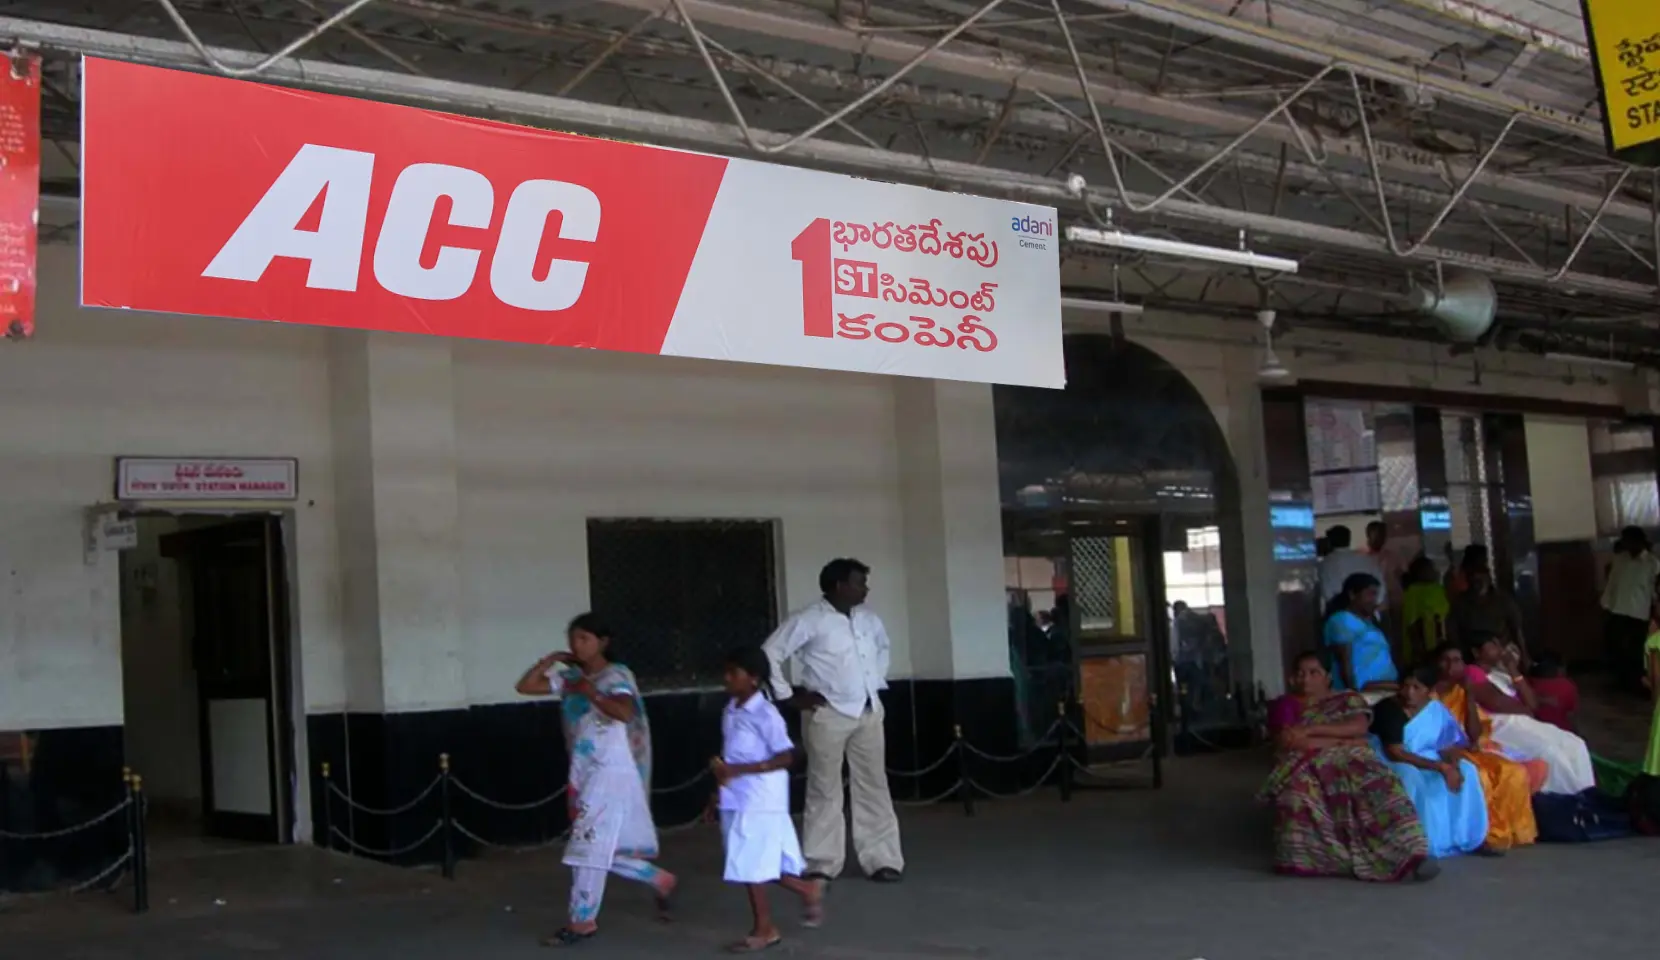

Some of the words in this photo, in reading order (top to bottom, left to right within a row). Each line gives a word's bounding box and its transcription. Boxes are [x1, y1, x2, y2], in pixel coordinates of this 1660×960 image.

[1621, 66, 1660, 96] स्टे
[201, 143, 600, 311] ACC
[833, 218, 998, 268] భారతదేశపు
[1011, 215, 1052, 236] adani
[1019, 239, 1047, 250] Cement
[880, 272, 998, 312] సిమెంట్
[836, 312, 998, 352] కంపెనీ
